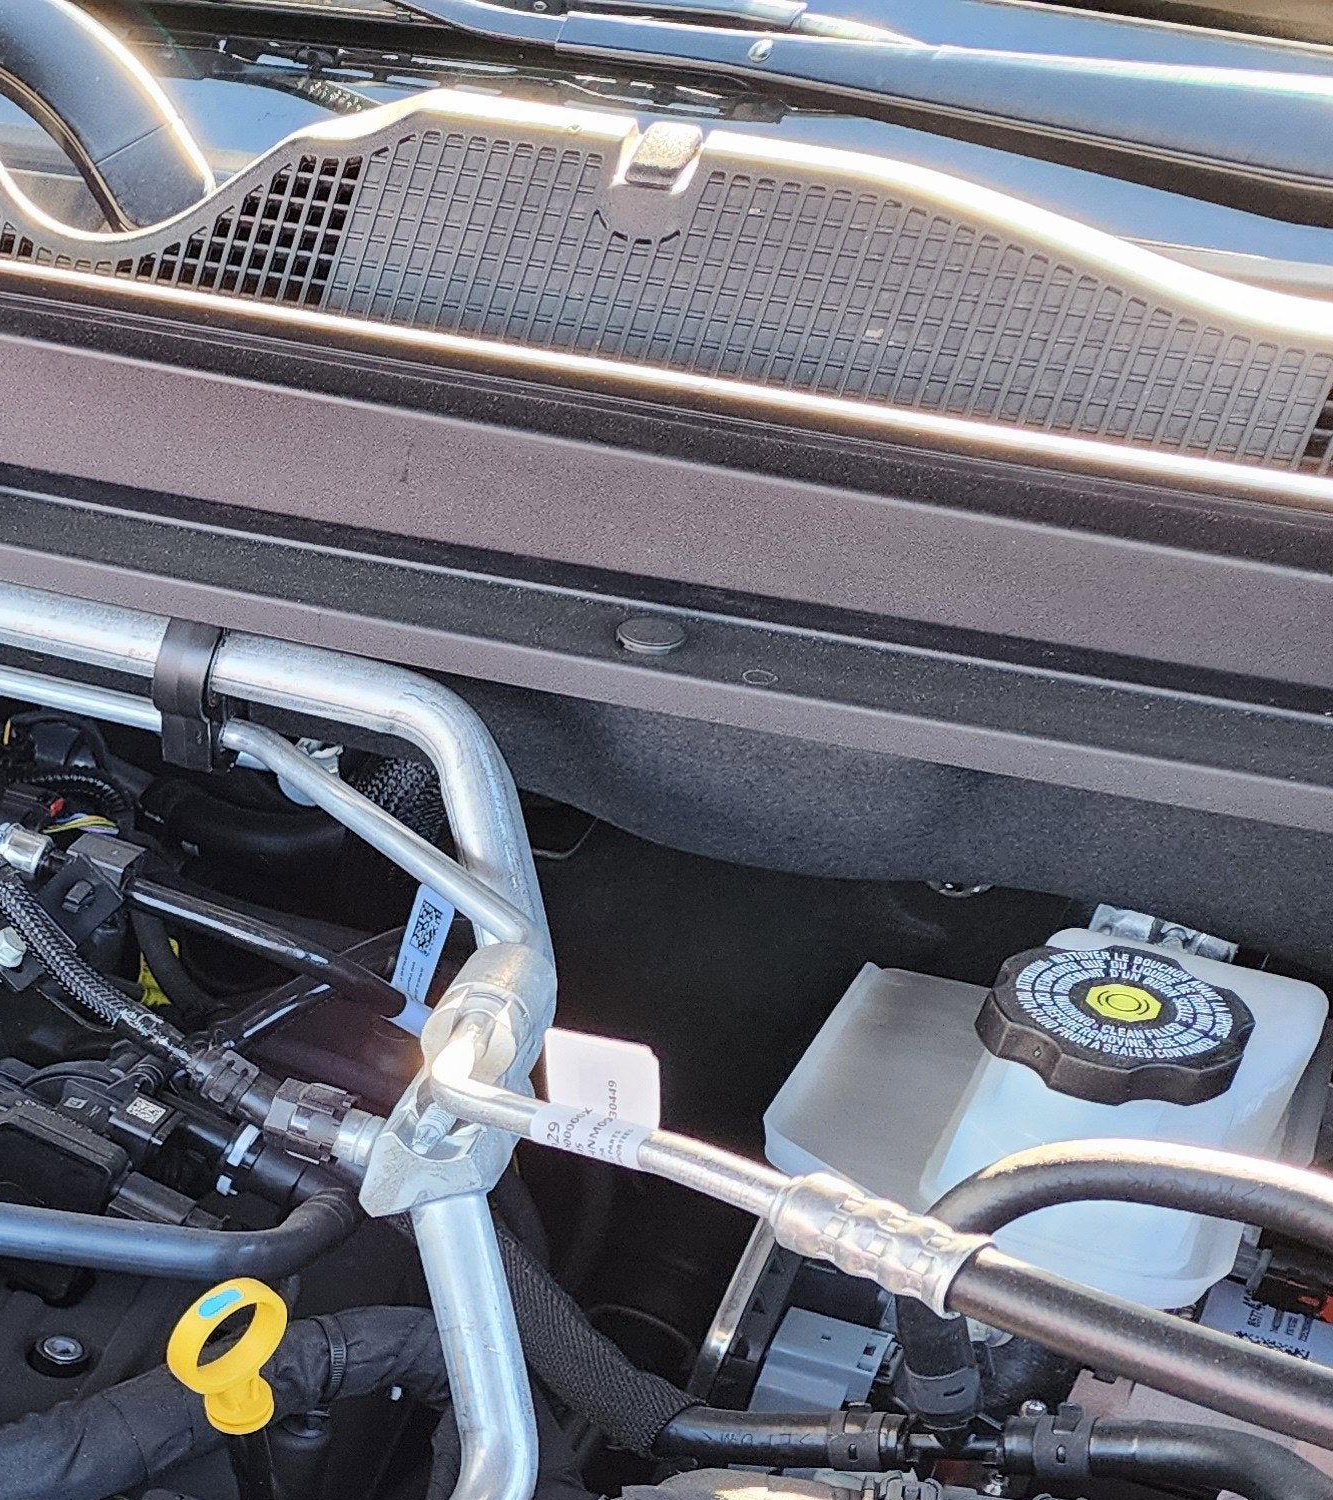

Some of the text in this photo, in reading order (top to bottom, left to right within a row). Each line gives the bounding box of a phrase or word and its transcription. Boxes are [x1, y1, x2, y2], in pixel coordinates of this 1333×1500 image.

[1049, 951, 1111, 963] NETTOYER
[1114, 952, 1130, 962] LE
[1133, 956, 1193, 981] BOUCHON
[1187, 980, 1223, 1000] AVANT
[1080, 960, 1107, 970] QUE
[1110, 960, 1128, 970] DU
[1132, 964, 1181, 985] LIQUIDE
[1110, 969, 1141, 982] D'UN
[1142, 977, 1182, 997] BIDON
[1025, 1008, 1060, 1030] FLUID
[1052, 1026, 1091, 1047] FROM
[1089, 1040, 1101, 1050] A
[1102, 1043, 1154, 1059] SEALED
[1042, 1005, 1084, 1032] BEFORE
[1152, 1037, 1176, 1048] USE
[1174, 1028, 1205, 1044] ONLY
[1100, 1024, 1145, 1039] CLEAN
[1144, 1022, 1188, 1038] FILLER
